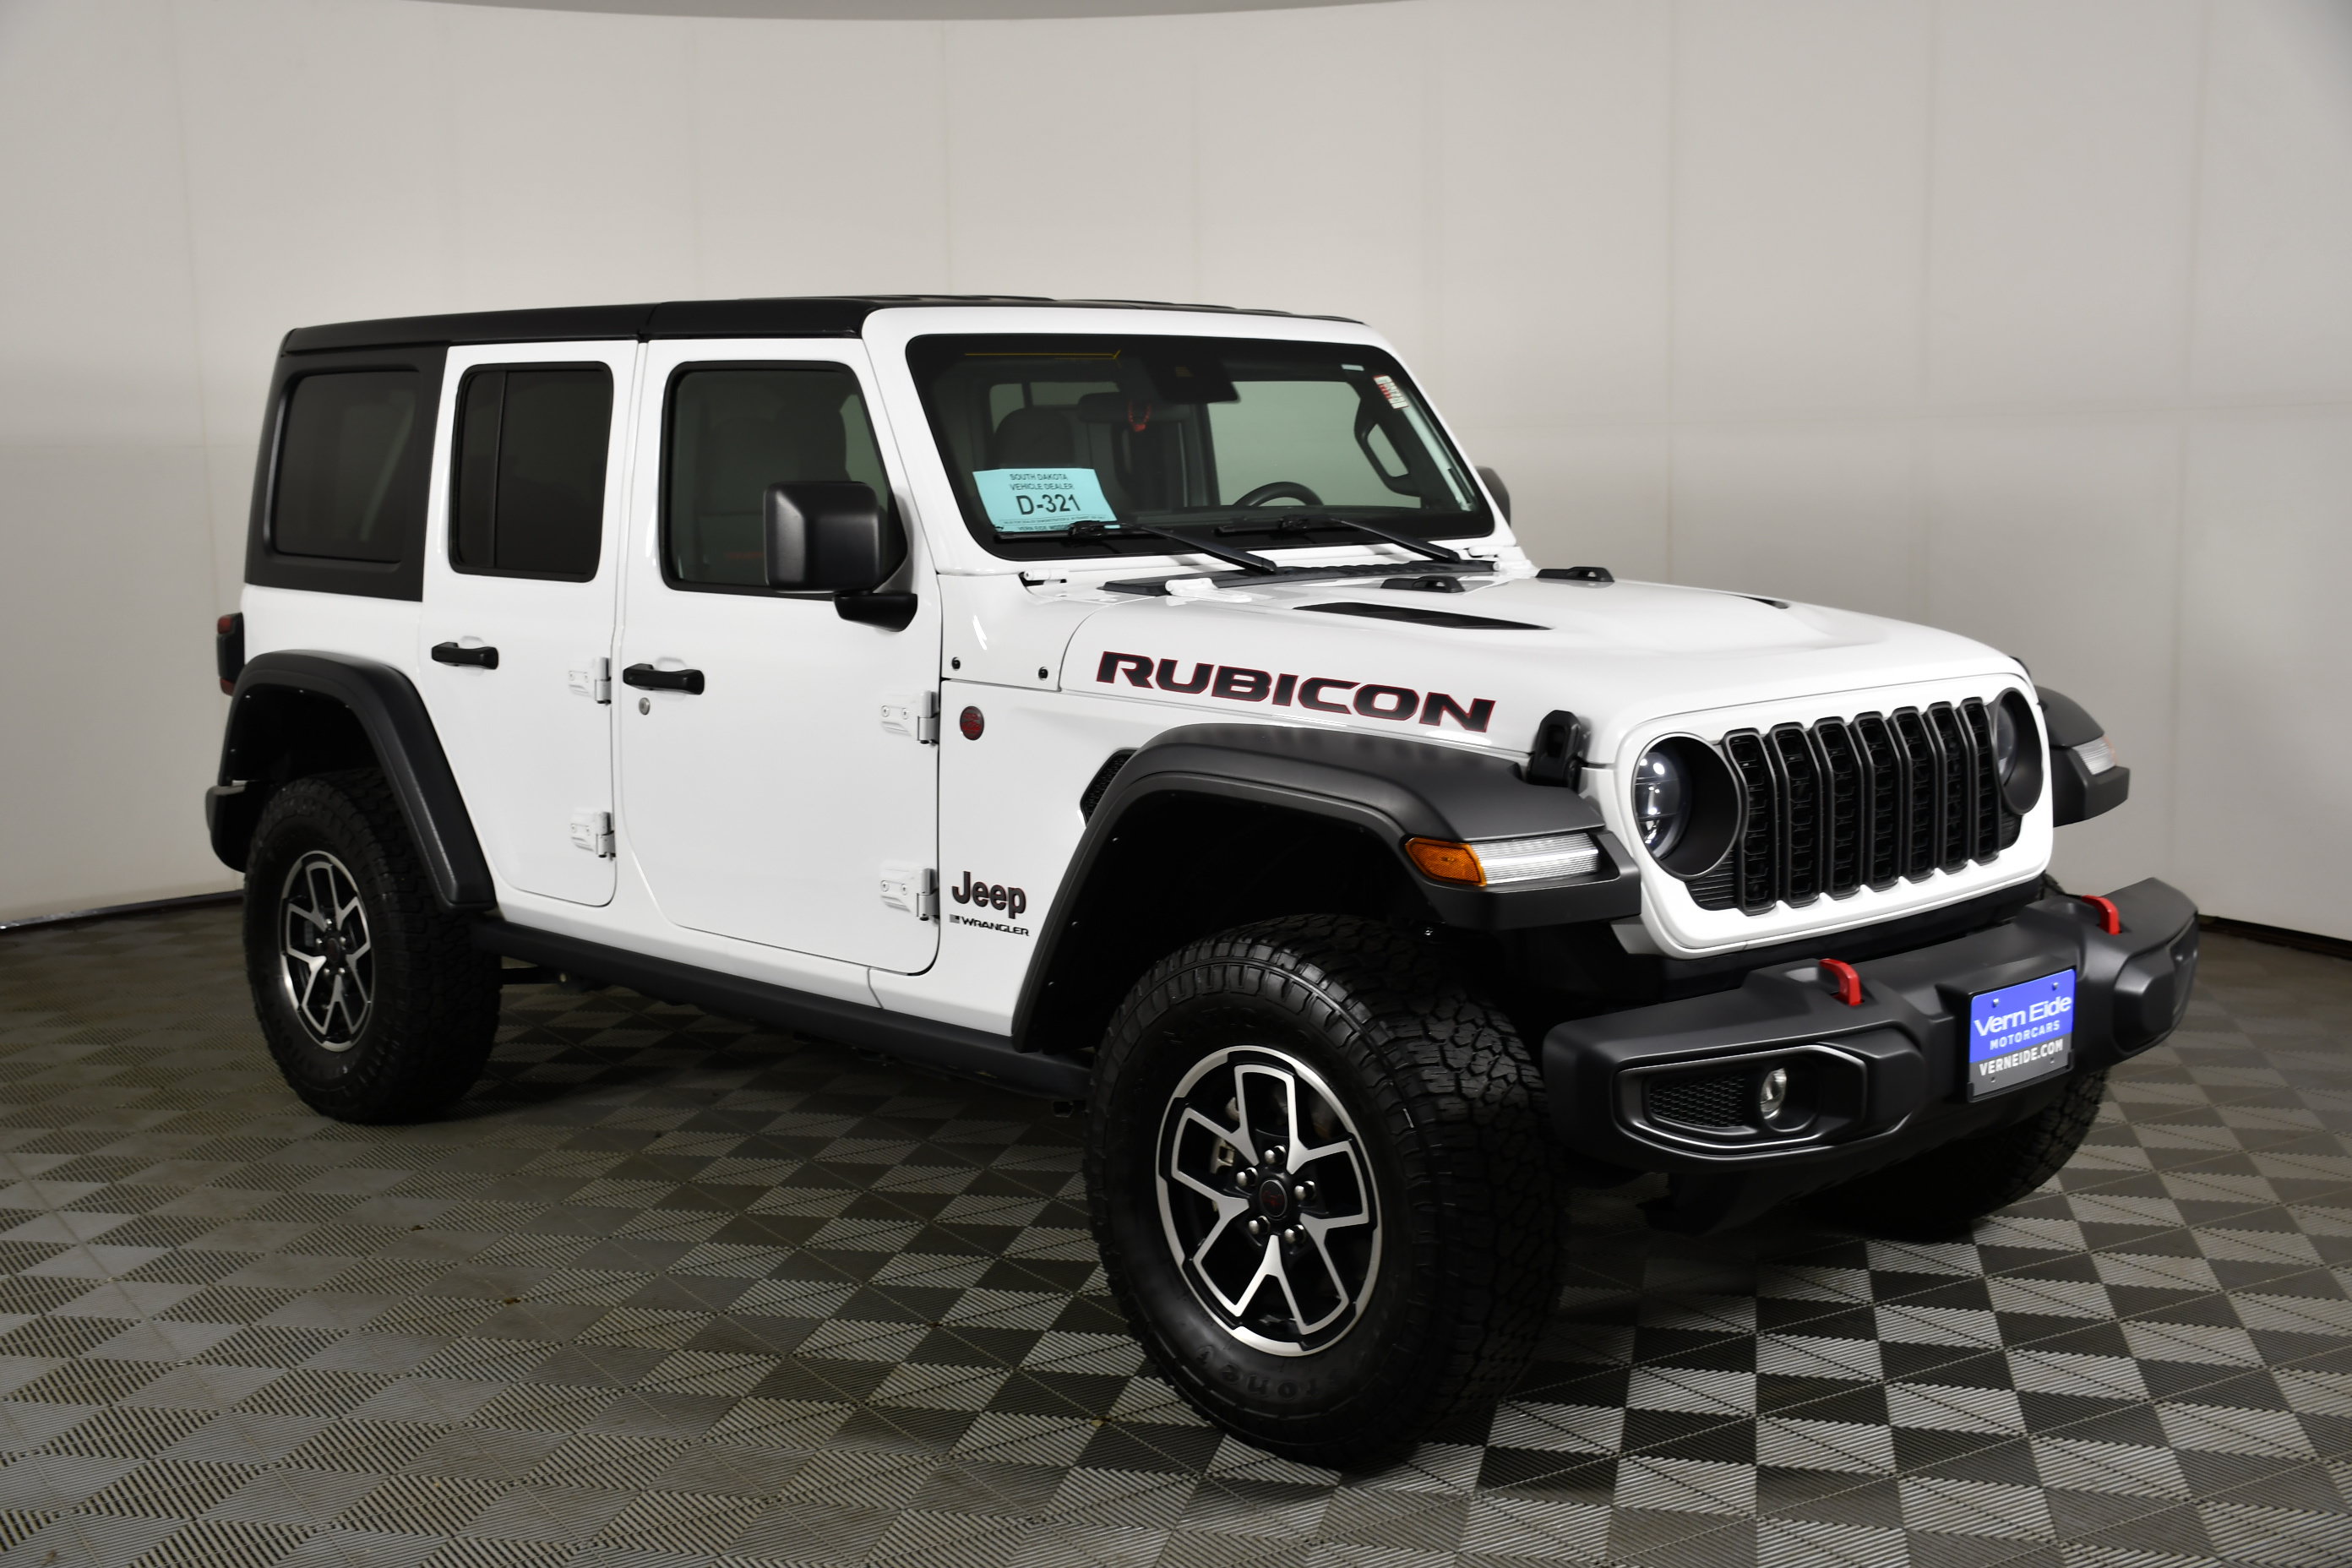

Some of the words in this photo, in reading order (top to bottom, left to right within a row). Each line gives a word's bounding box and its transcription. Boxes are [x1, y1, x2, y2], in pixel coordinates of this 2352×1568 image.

[1015, 493, 1081, 514] D-321
[1096, 651, 1497, 733] RUBICON
[951, 870, 1026, 919] Jeep
[961, 916, 1030, 937] WRANGLER
[1974, 1010, 2026, 1037] Vern
[2028, 995, 2072, 1022] Eide
[1989, 1020, 2061, 1050] MOTORCARS
[1979, 1038, 2064, 1076] VERNEIDE.COM
